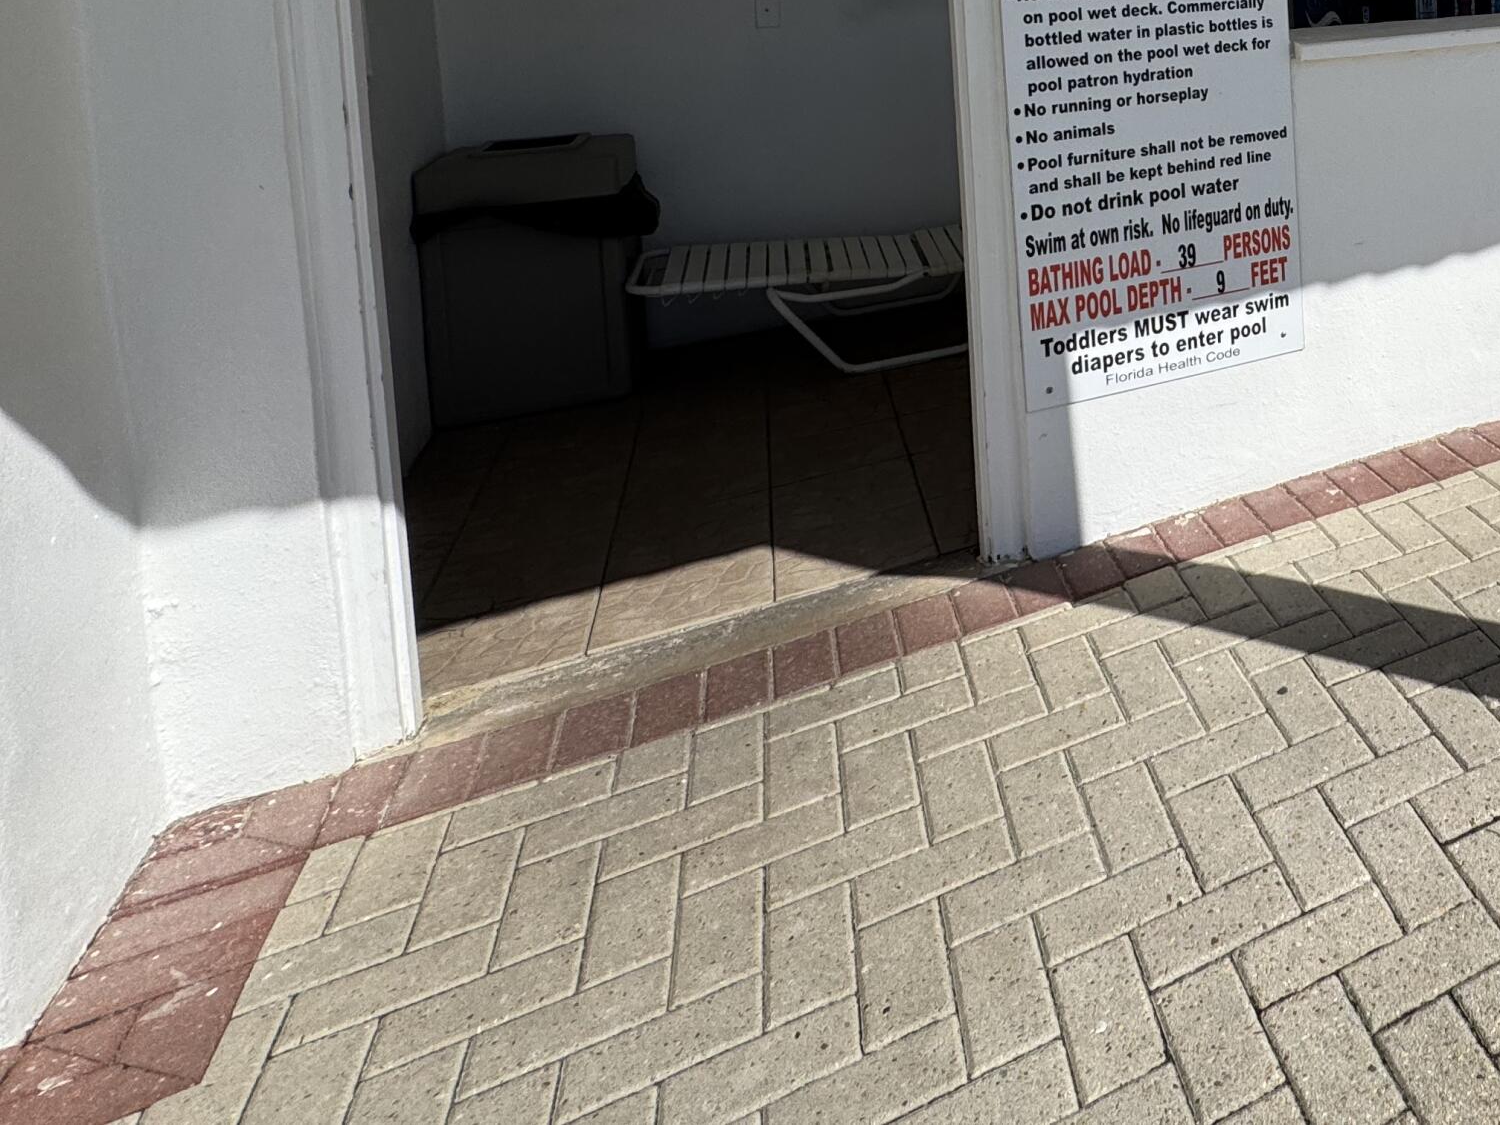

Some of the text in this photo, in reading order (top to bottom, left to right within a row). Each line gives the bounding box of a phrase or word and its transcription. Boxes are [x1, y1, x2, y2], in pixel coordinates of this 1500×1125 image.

[1023, 13, 1043, 25] on
[1048, 7, 1082, 25] pool
[1087, 6, 1116, 20] wet
[1121, 3, 1163, 17] deck.
[1024, 17, 1274, 47] bottled water in plastic bottles is
[1026, 37, 1270, 71] allowed on the pool wet deck for
[1024, 87, 1208, 117] No running or horseplay
[1028, 67, 1194, 97] pool patron hydration
[1026, 123, 1115, 145] No animals
[1028, 127, 1287, 171] Pool furniture shall not be removed
[1028, 151, 1272, 195] and shall be kept behind red line
[1030, 177, 1240, 221] Do not drink pool water
[1026, 195, 1294, 257] Swim at own risk. No lifeguard on duty.
[1028, 256, 1104, 297] BATHING
[1110, 249, 1152, 281] LOAD
[1178, 243, 1197, 269] 39
[1223, 225, 1290, 261] PERSONS
[1030, 298, 1070, 331] MAX
[1076, 286, 1122, 322] POOL
[1127, 277, 1182, 312] DEPTH
[1216, 271, 1226, 293] 9
[1250, 257, 1288, 287] FEET
[1040, 293, 1290, 357] Toddlers MUST wear swim
[1072, 317, 1267, 375] diapers to enter pool
[1106, 347, 1240, 385] Florida Health Code
